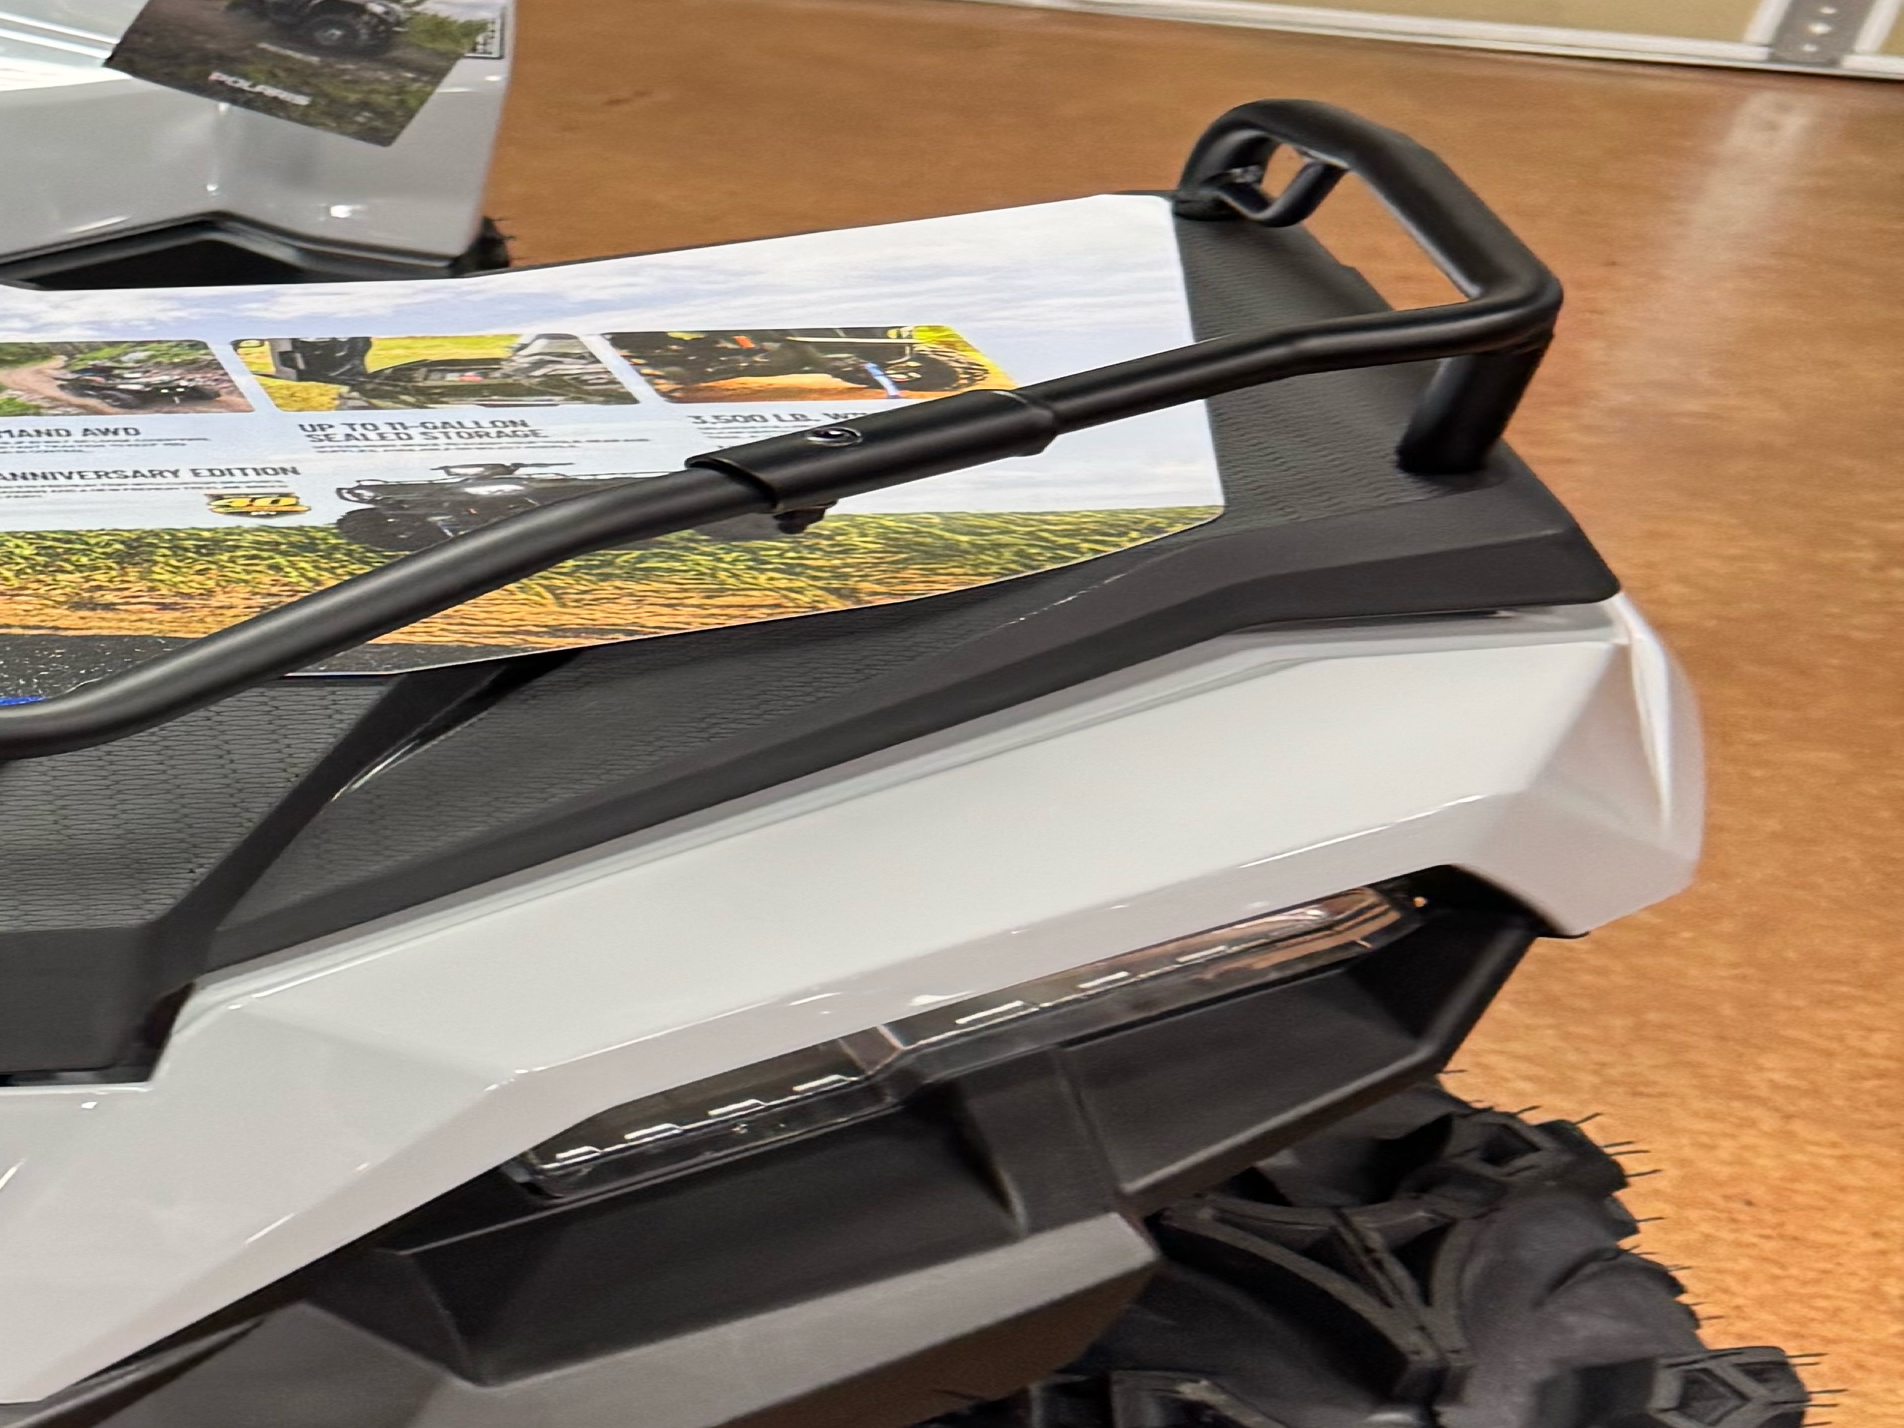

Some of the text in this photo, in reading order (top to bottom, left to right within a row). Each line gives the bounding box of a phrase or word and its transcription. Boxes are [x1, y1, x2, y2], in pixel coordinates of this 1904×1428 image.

[208, 70, 312, 106] POLARIS
[82, 427, 142, 437] AWD
[299, 423, 336, 433] UP
[341, 422, 381, 431] TO
[305, 429, 550, 443] SEALED STORAGE
[191, 466, 301, 477] EDITION
